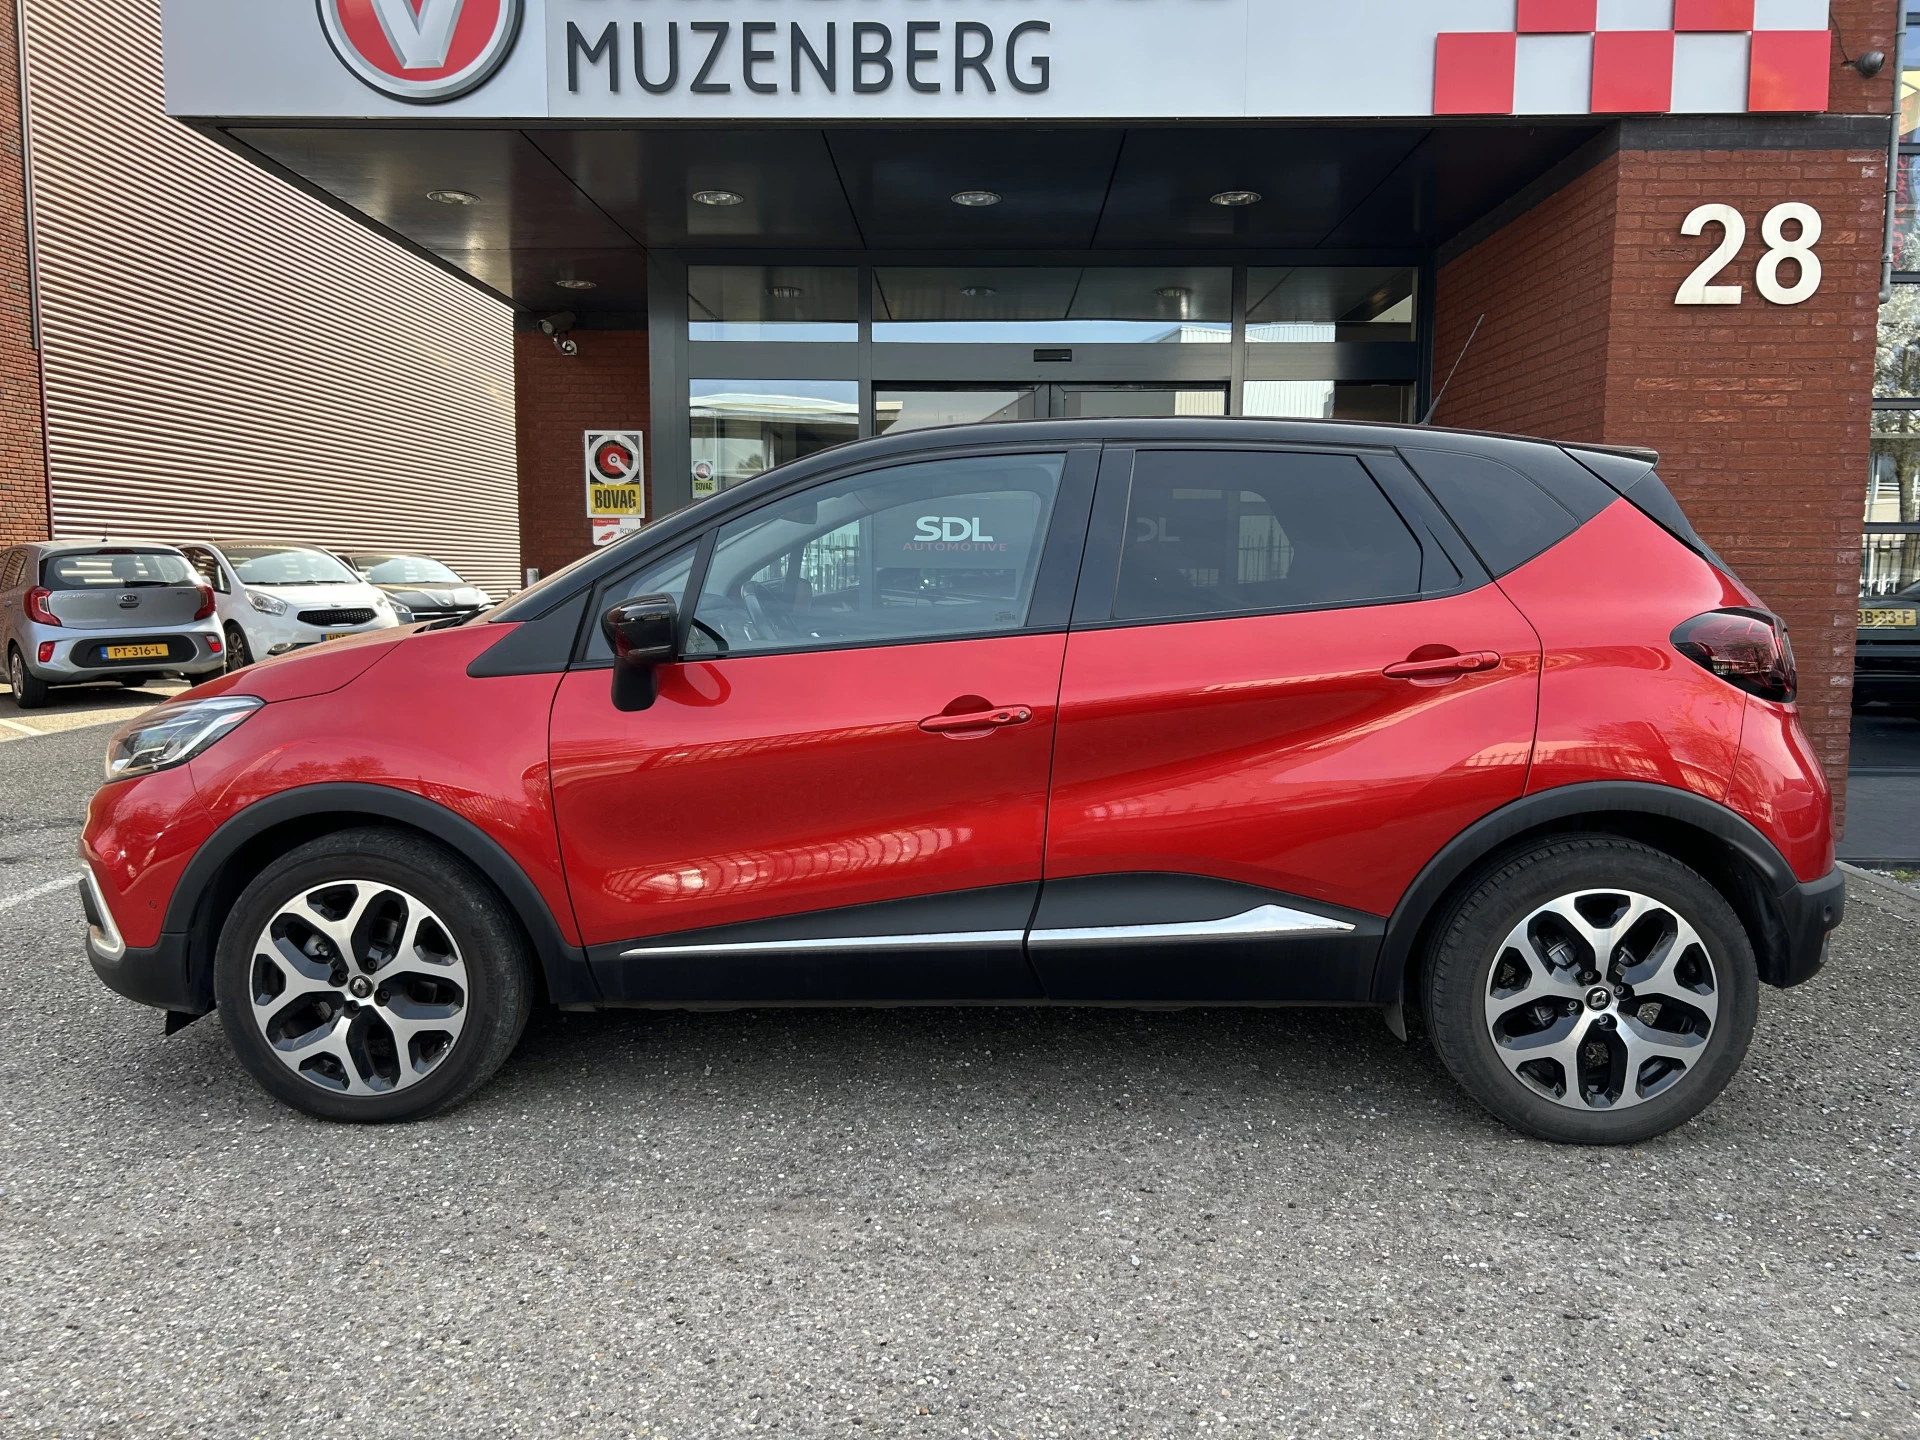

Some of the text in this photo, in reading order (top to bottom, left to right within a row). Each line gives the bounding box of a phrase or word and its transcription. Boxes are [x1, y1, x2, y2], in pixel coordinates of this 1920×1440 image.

[566, 20, 1052, 94] MUZENBERG
[1674, 201, 1822, 305] 28
[695, 482, 713, 491] BOVAG
[594, 488, 637, 509] BOVAG
[913, 515, 994, 542] SDL
[902, 541, 1009, 552] AUTOMOTIVE
[113, 645, 162, 657] PT-316-L
